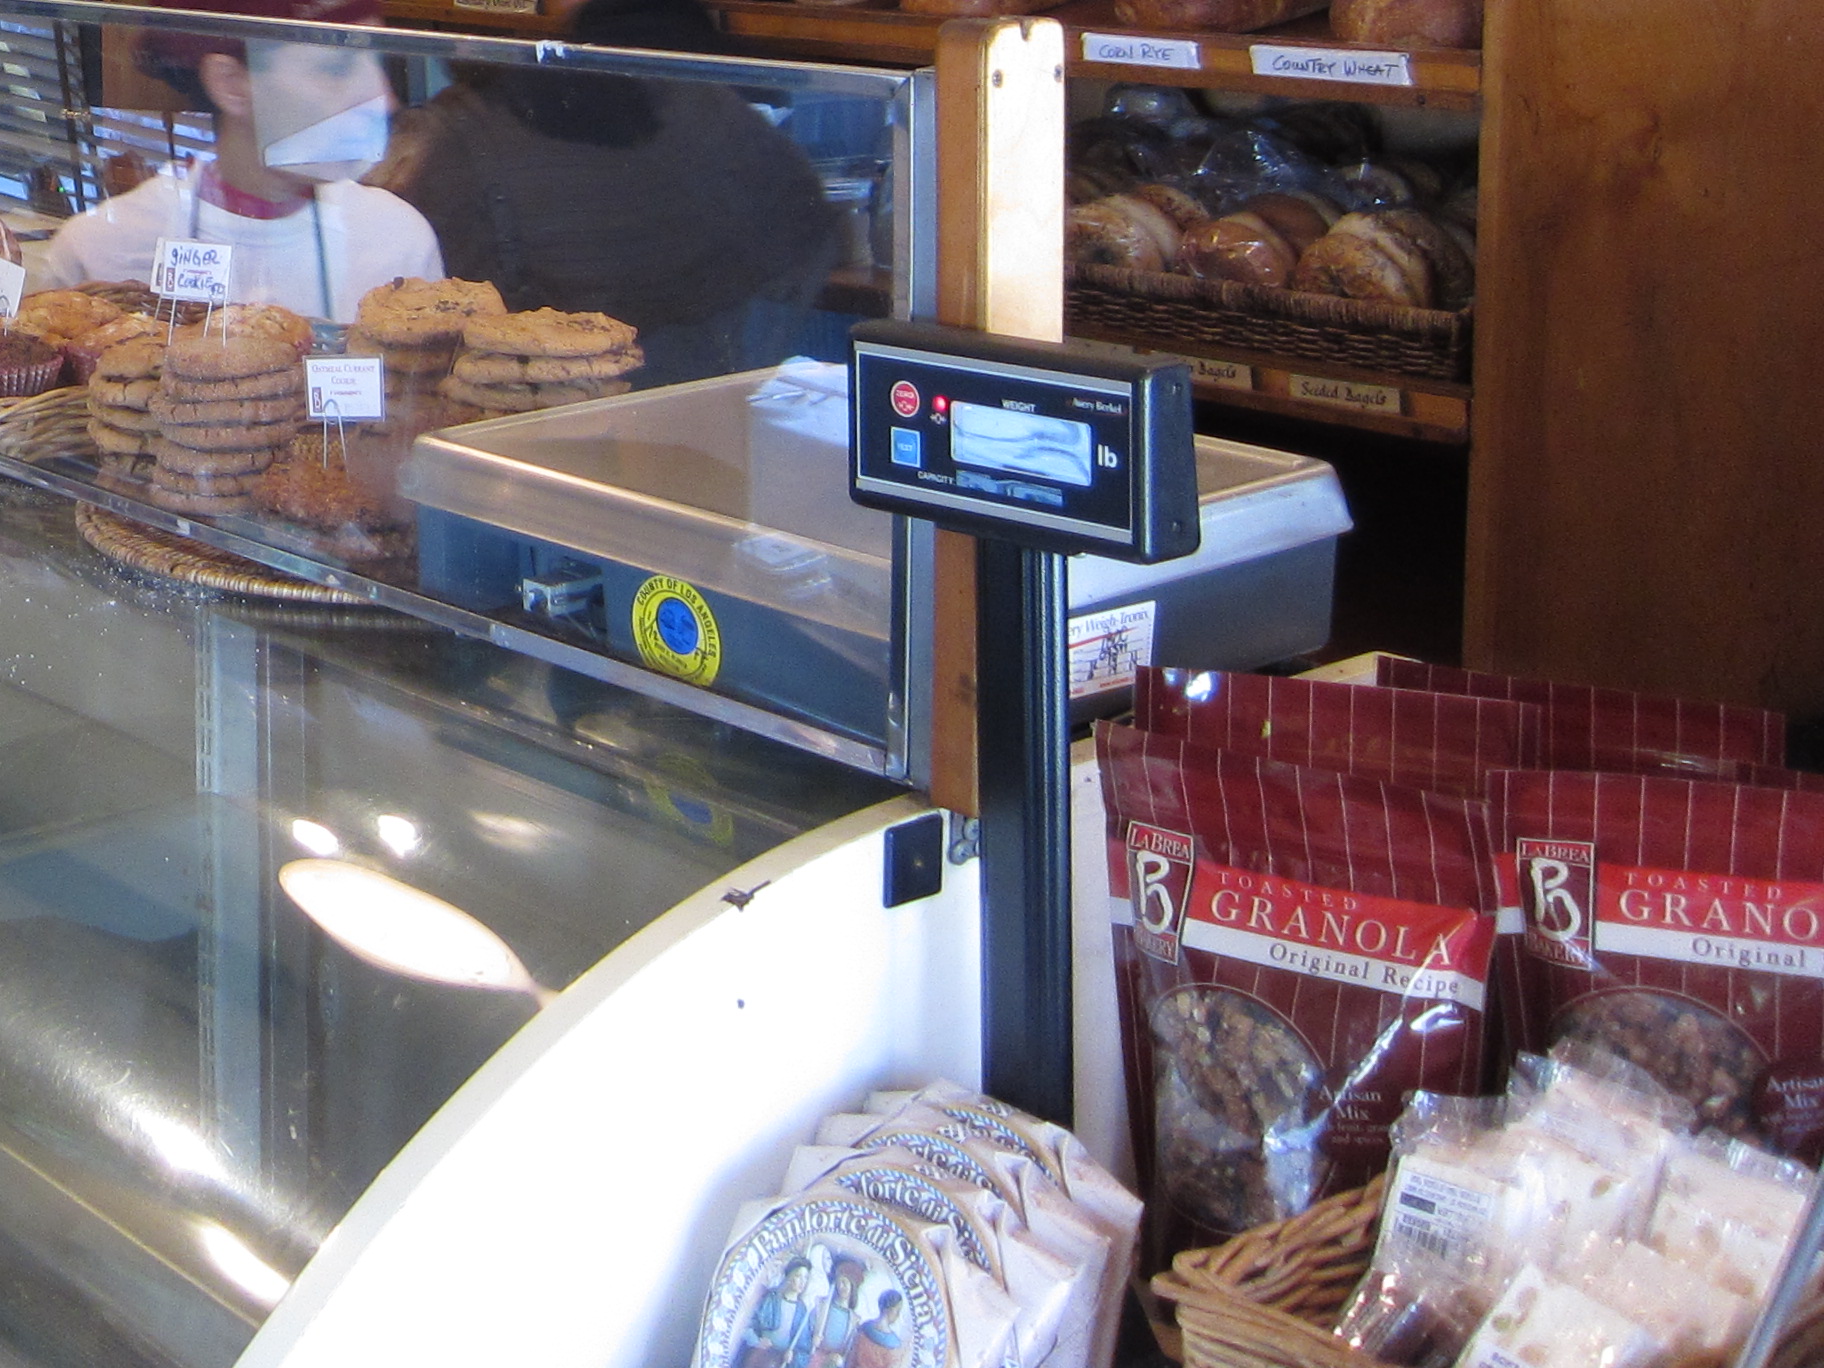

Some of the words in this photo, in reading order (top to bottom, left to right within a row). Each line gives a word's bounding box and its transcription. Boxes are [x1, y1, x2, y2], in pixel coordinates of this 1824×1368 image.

[1098, 44, 1134, 60] CORN
[1141, 43, 1176, 61] RYE
[1272, 54, 1337, 77] COUNTRY
[1343, 61, 1401, 78] WHEAT
[344, 365, 375, 374] CURRANT
[1199, 360, 1237, 382] Bagels
[1001, 398, 1036, 413] WEIGHT
[1301, 381, 1339, 401] Seeded
[1346, 388, 1388, 409] Bagels
[1097, 444, 1118, 468] lb
[918, 470, 954, 485] CAPACITY
[636, 578, 664, 606] COUNTY
[666, 577, 678, 591] OF
[680, 584, 698, 605] LOS
[697, 604, 717, 659] ANGELES
[1135, 849, 1174, 934] B
[1217, 870, 1358, 912] TOASTED
[1530, 856, 1582, 941] B
[1626, 871, 1783, 901] TOASTED
[1210, 888, 1453, 967] GRANOLA
[1691, 936, 1807, 969] Original
[1269, 941, 1370, 980] Original
[1382, 966, 1460, 998] Recipe
[751, 1203, 867, 1261] Panforte
[866, 1224, 890, 1254] di
[885, 1238, 937, 1328] Siena
